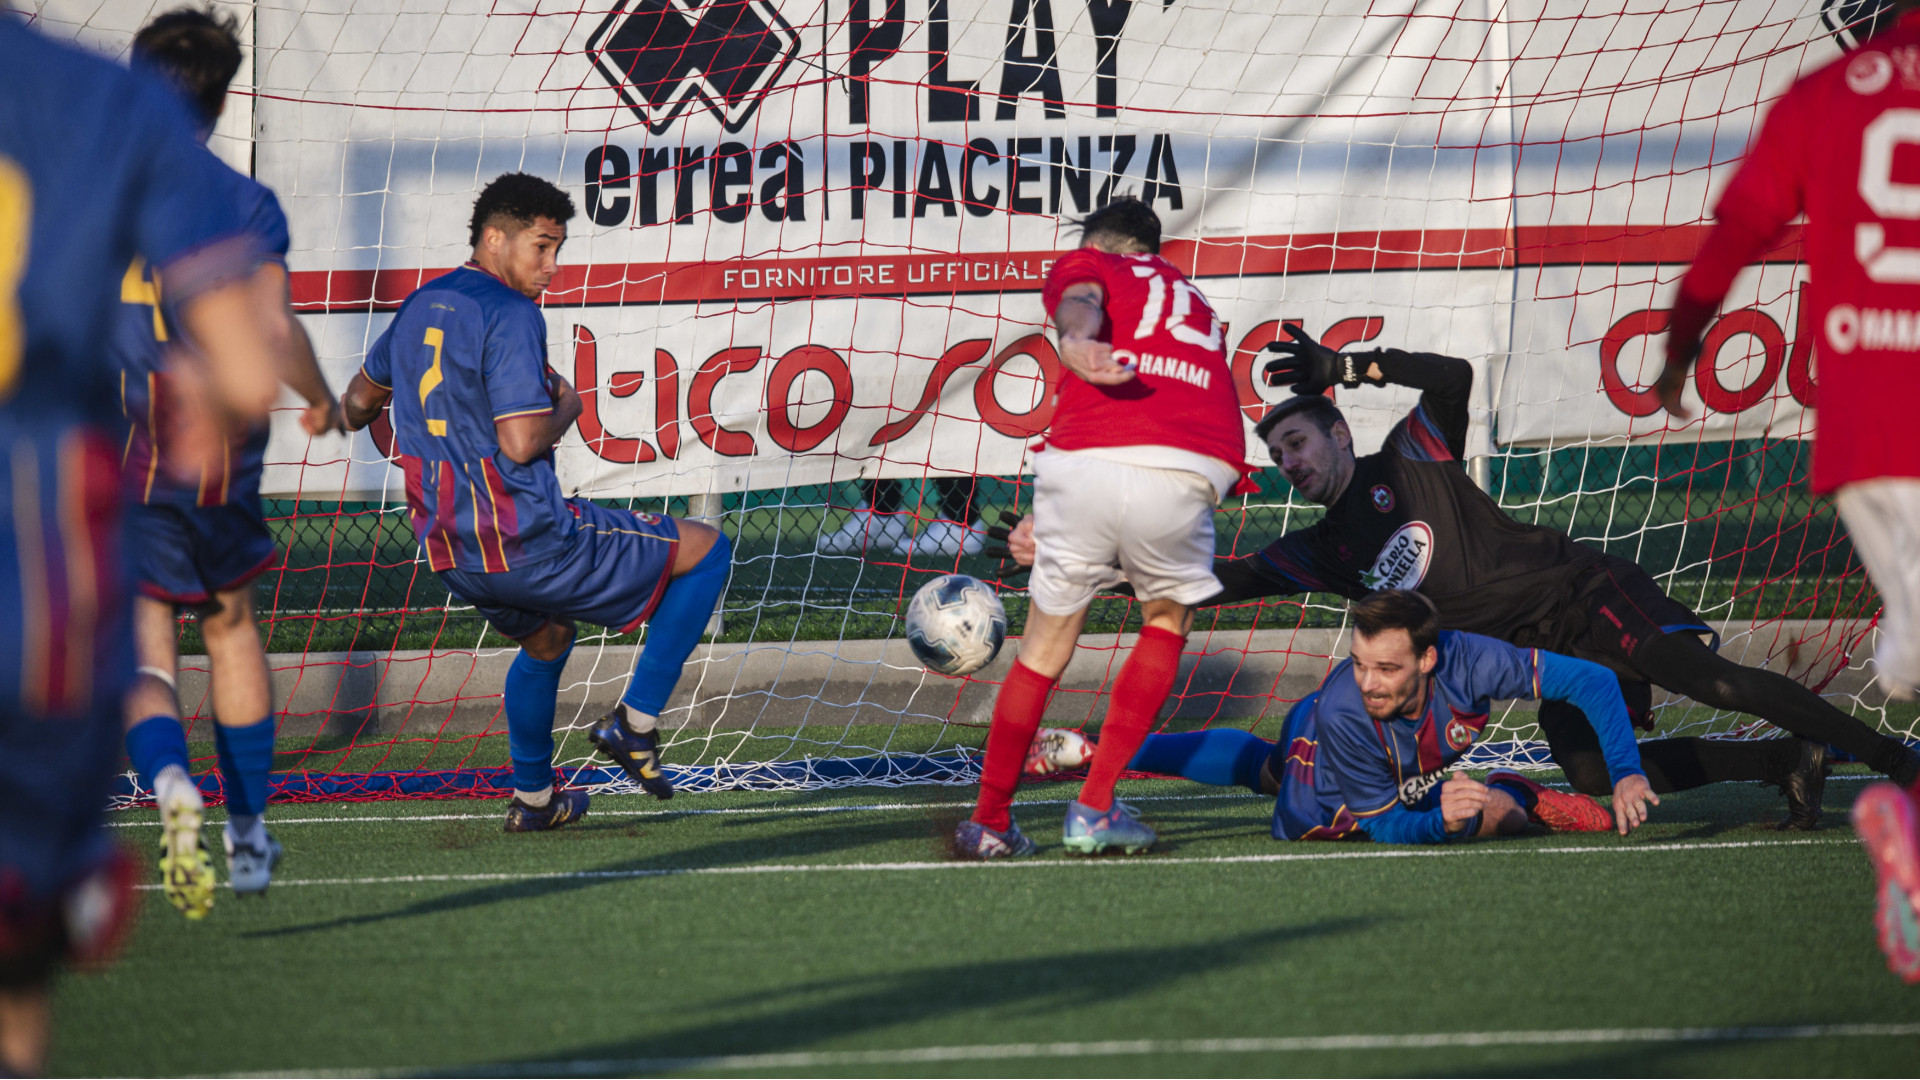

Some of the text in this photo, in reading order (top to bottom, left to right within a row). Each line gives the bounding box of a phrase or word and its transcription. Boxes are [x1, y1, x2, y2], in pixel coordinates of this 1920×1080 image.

[850, 134, 1184, 220] PIACENZA
[723, 259, 1058, 290] FORNITORE UFFICIALE
[418, 326, 448, 438] 2
[1138, 352, 1212, 391] HANAMI
[1378, 534, 1410, 578] CARLO
